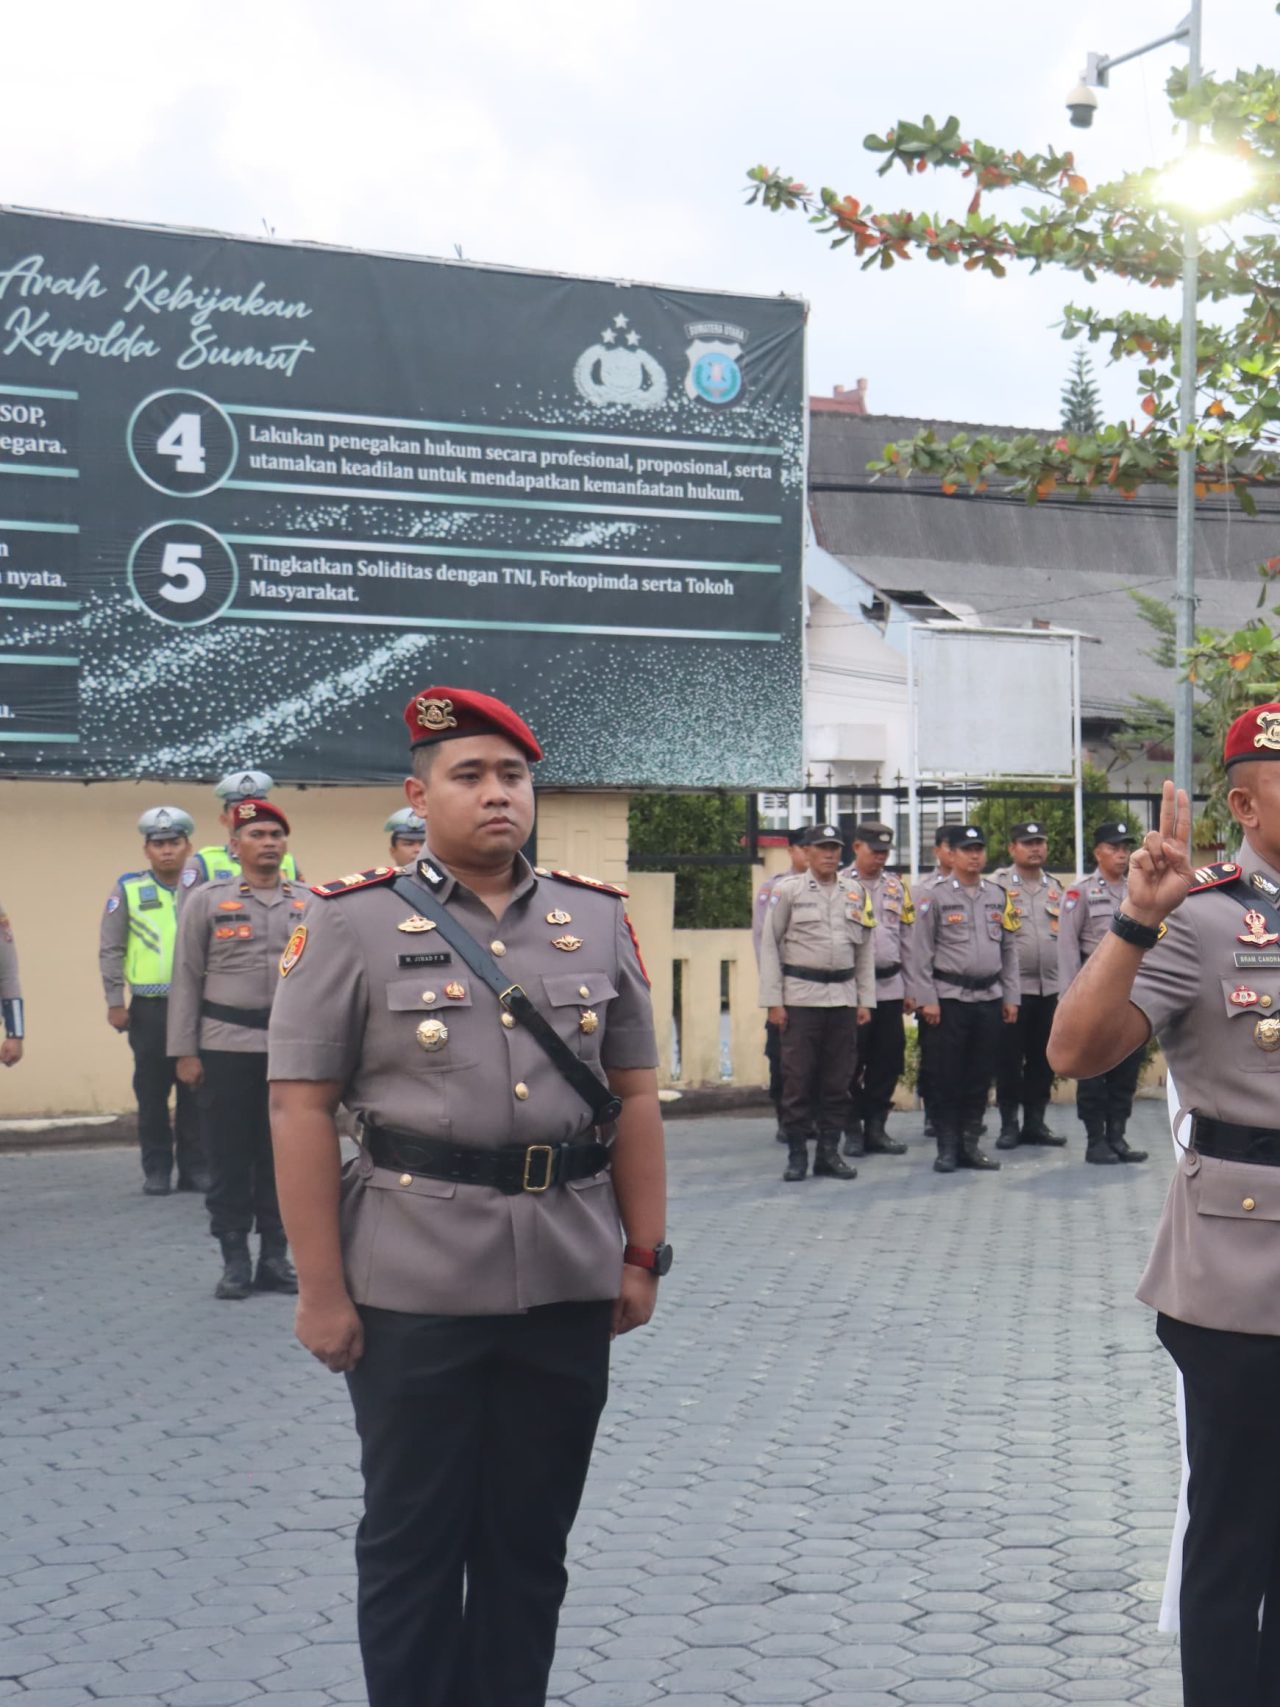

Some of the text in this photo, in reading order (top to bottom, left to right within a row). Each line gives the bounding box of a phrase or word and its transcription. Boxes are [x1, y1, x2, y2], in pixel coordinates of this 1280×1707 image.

[0, 255, 312, 325] Arah Kebijakan
[4, 306, 316, 377] Kapolda Sumut
[0, 404, 46, 428] SOP,
[157, 412, 206, 473] 4
[250, 425, 772, 480] Lakukan penegakan hukum secara profesional, proposional, serta
[250, 454, 744, 501] utamakan keadilan untuk mendapatkan kemanfaatan hukum.
[7, 570, 67, 589] nyata.
[158, 543, 207, 603] 5
[250, 554, 735, 595] Tingkatkan Soliditas dengan TNI, Forkopimda serta Tokoh
[250, 580, 359, 602] Masyarakat.
[1240, 955, 1280, 963] BRAM CANDRA
